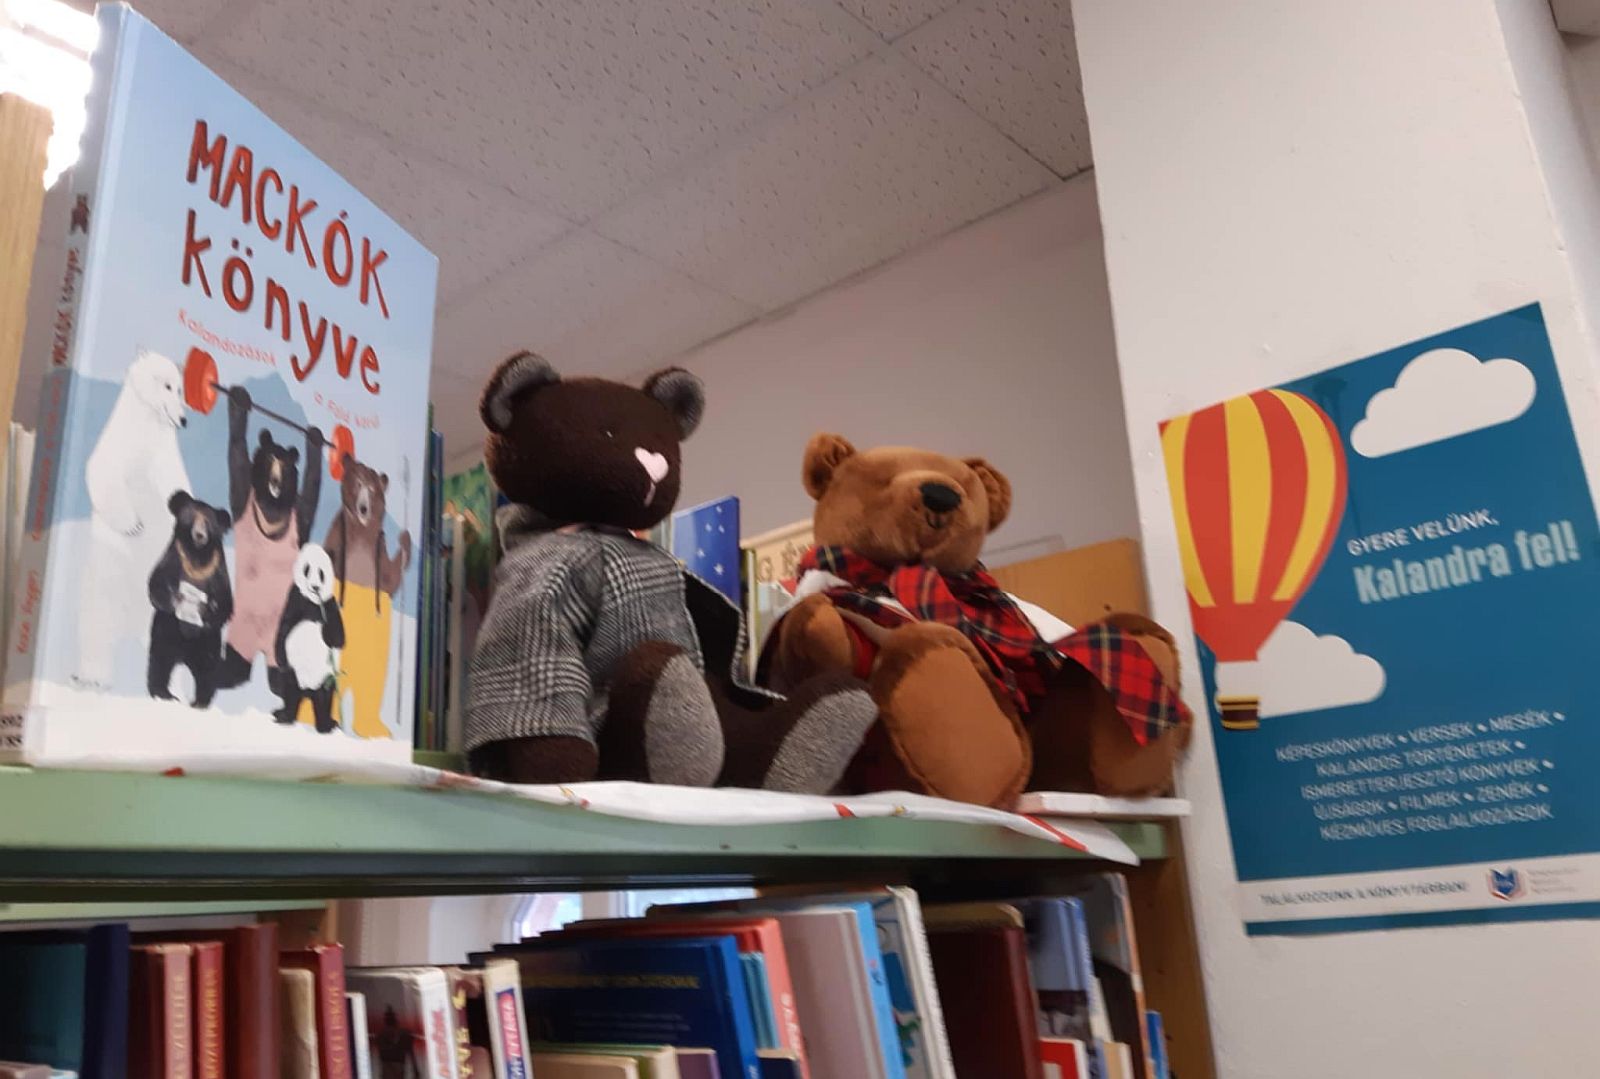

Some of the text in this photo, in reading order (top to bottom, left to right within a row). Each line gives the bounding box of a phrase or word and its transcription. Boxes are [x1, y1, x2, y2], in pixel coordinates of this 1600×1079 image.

[186, 119, 391, 320] MACKÓK
[181, 208, 381, 395] könyve
[1347, 528, 1410, 556] GYERE
[1353, 519, 1581, 605] Kalandra fel!
[1407, 722, 1477, 744] VERSEK
[1489, 709, 1553, 732] MESÉK
[1315, 753, 1404, 778] KALANDOS
